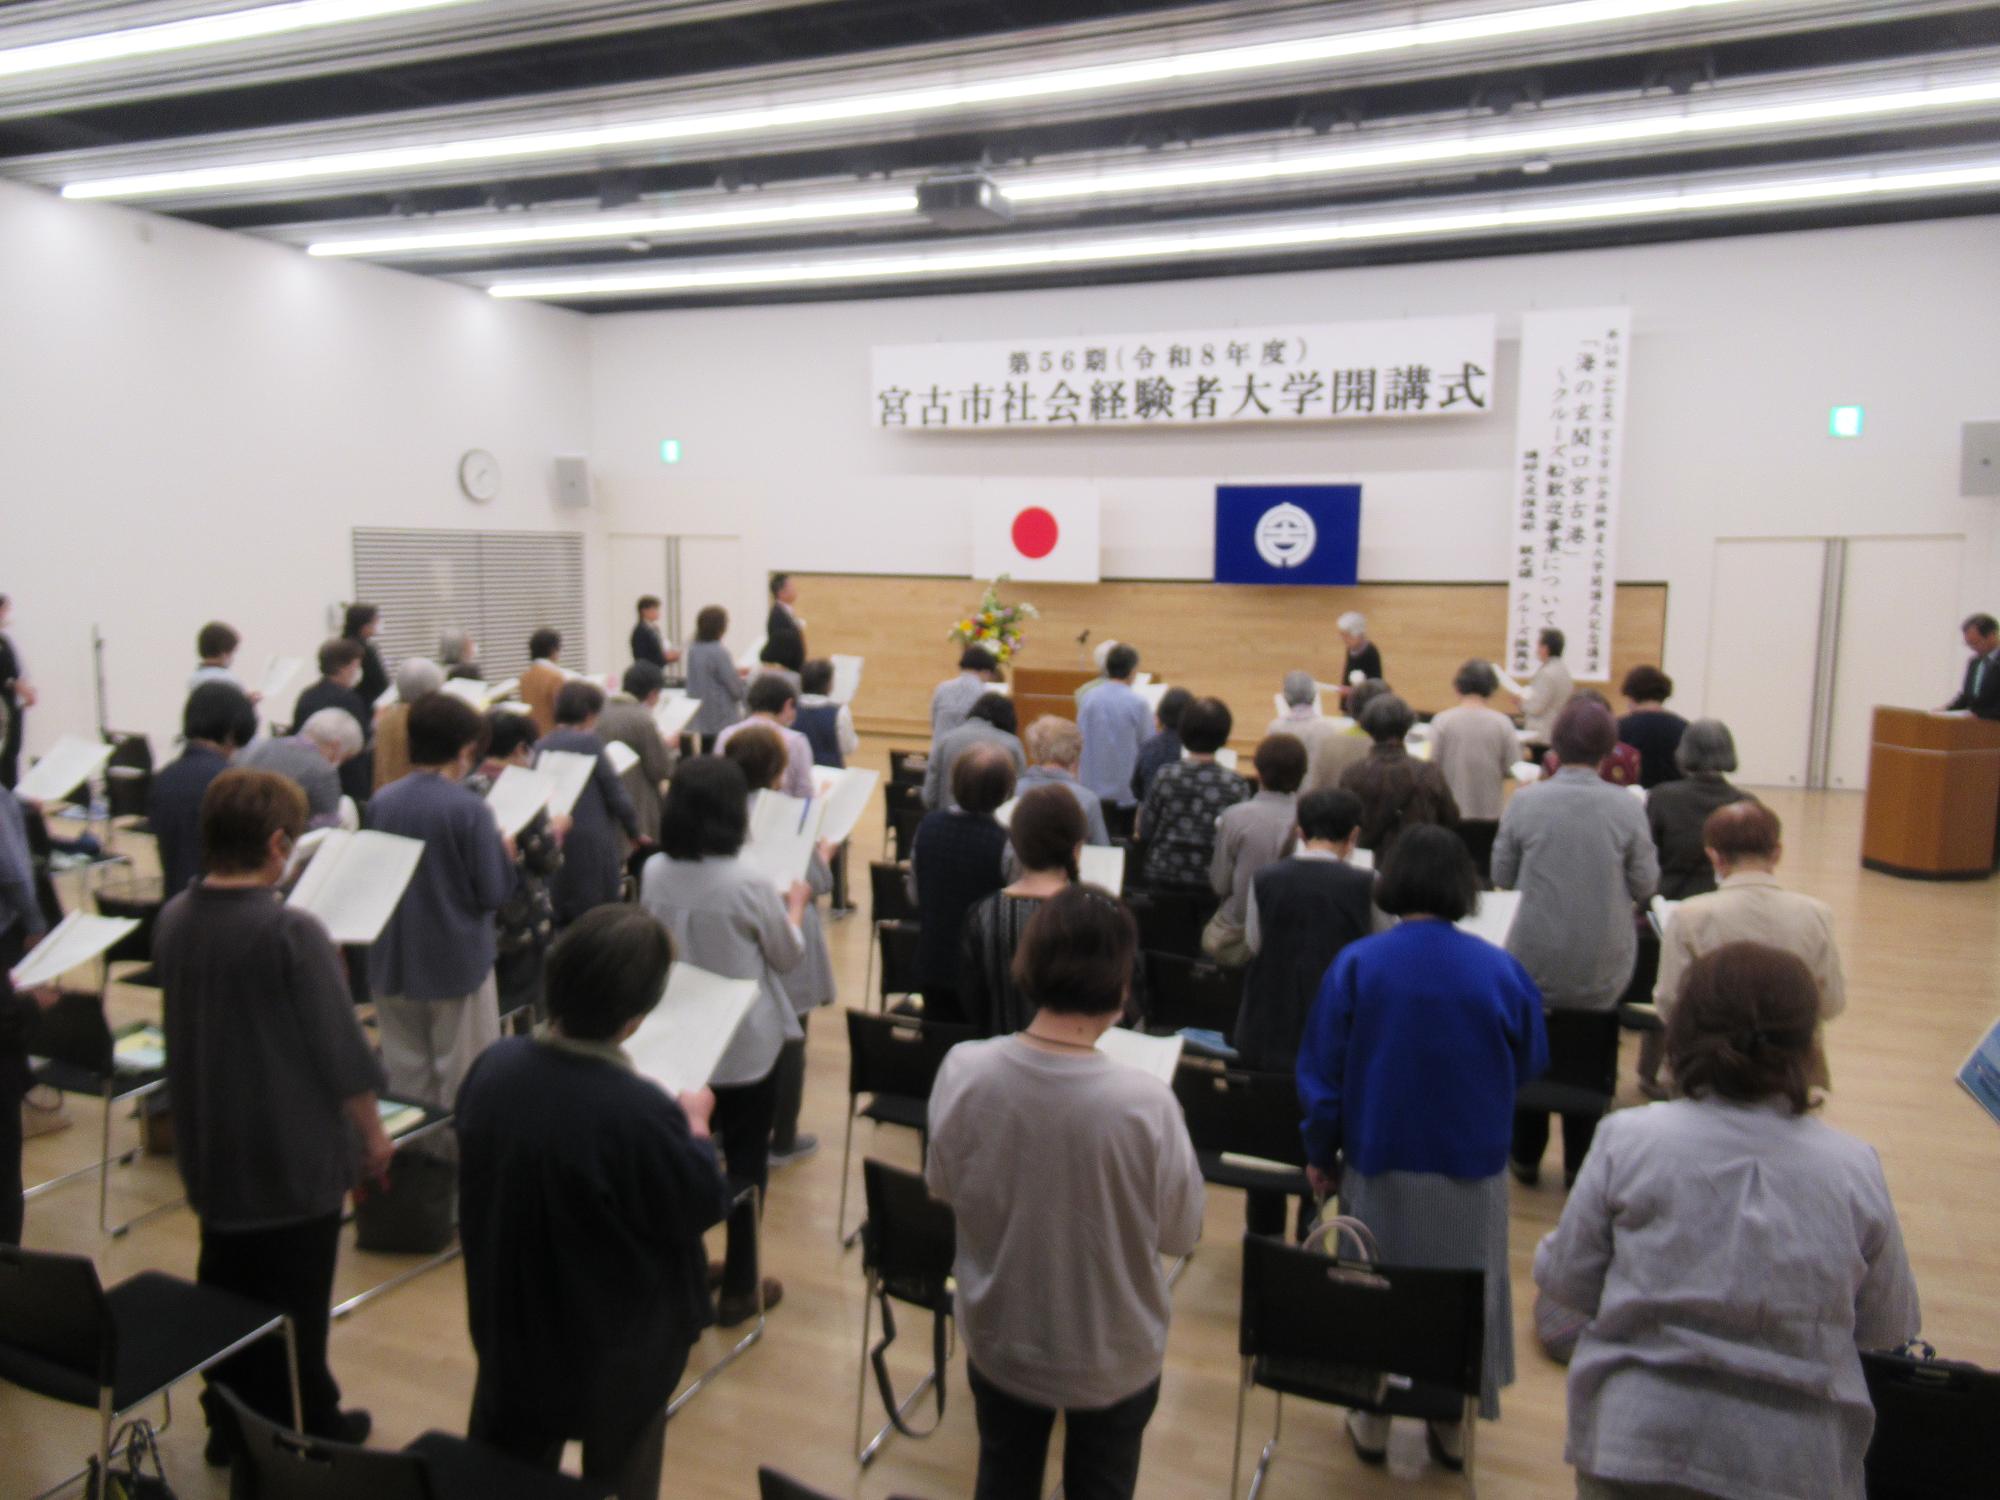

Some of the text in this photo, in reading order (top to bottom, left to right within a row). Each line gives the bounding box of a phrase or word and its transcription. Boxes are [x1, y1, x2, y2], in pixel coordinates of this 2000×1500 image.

[1009, 339, 1310, 373] 第56期（令和8年度）
[879, 362, 1488, 427] 宮古市社会経験者大学開講式
